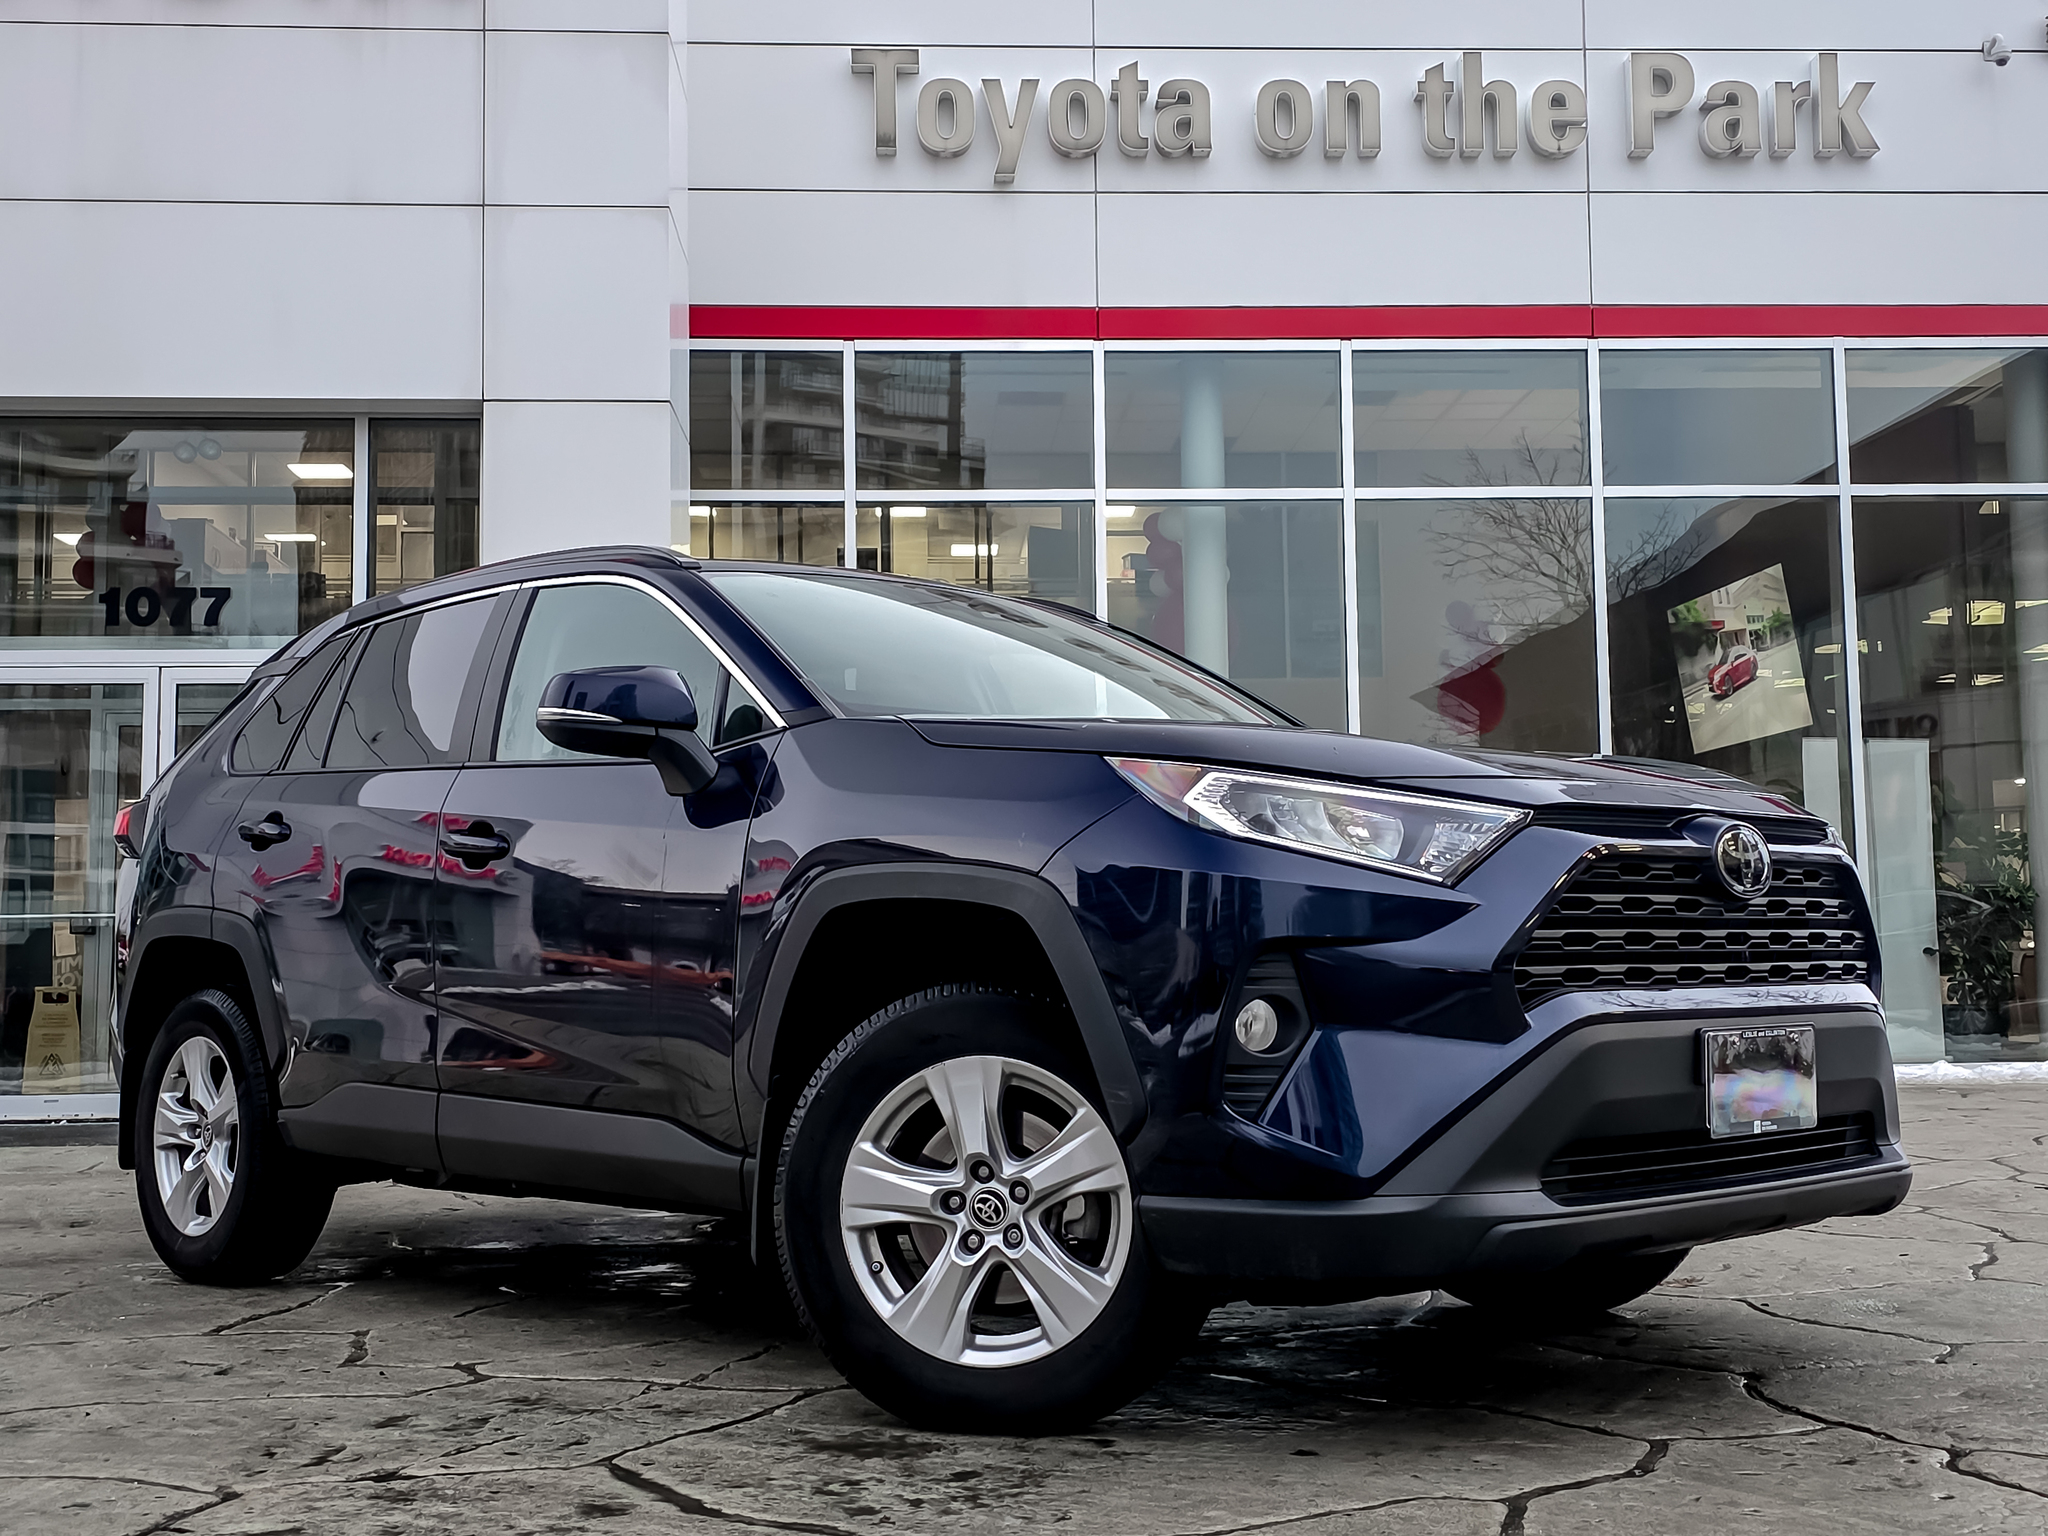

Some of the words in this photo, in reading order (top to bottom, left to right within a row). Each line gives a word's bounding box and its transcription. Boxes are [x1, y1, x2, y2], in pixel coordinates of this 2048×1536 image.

[850, 48, 1213, 184] Toyota
[1254, 78, 1382, 158] on
[1414, 51, 1588, 158] the
[1624, 51, 1881, 160] Park
[98, 586, 232, 627] 1077
